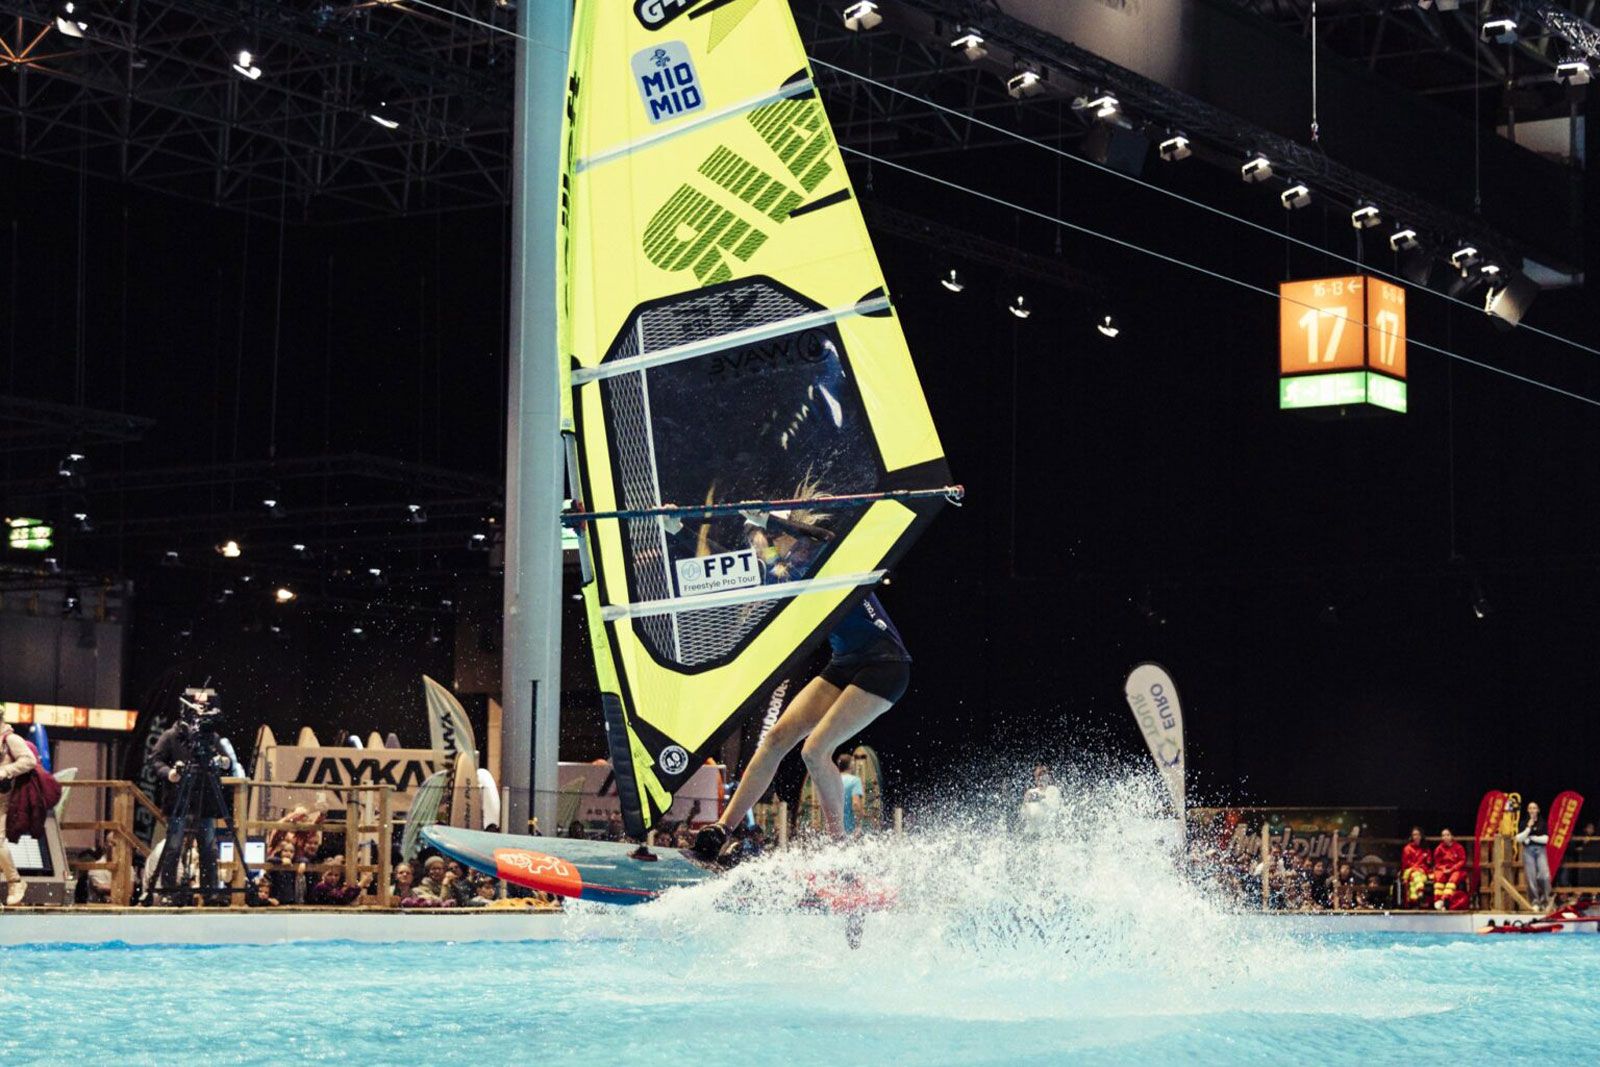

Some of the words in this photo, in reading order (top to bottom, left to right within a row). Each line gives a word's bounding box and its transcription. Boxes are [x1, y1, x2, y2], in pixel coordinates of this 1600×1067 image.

[641, 62, 693, 97] MIO
[650, 85, 701, 120] MIO
[1298, 306, 1349, 364] 17
[1375, 309, 1400, 366] 17
[703, 553, 753, 578] FPT
[683, 581, 721, 592] Freestyle
[737, 575, 757, 584] Tour
[288, 757, 435, 803] JAYKA
